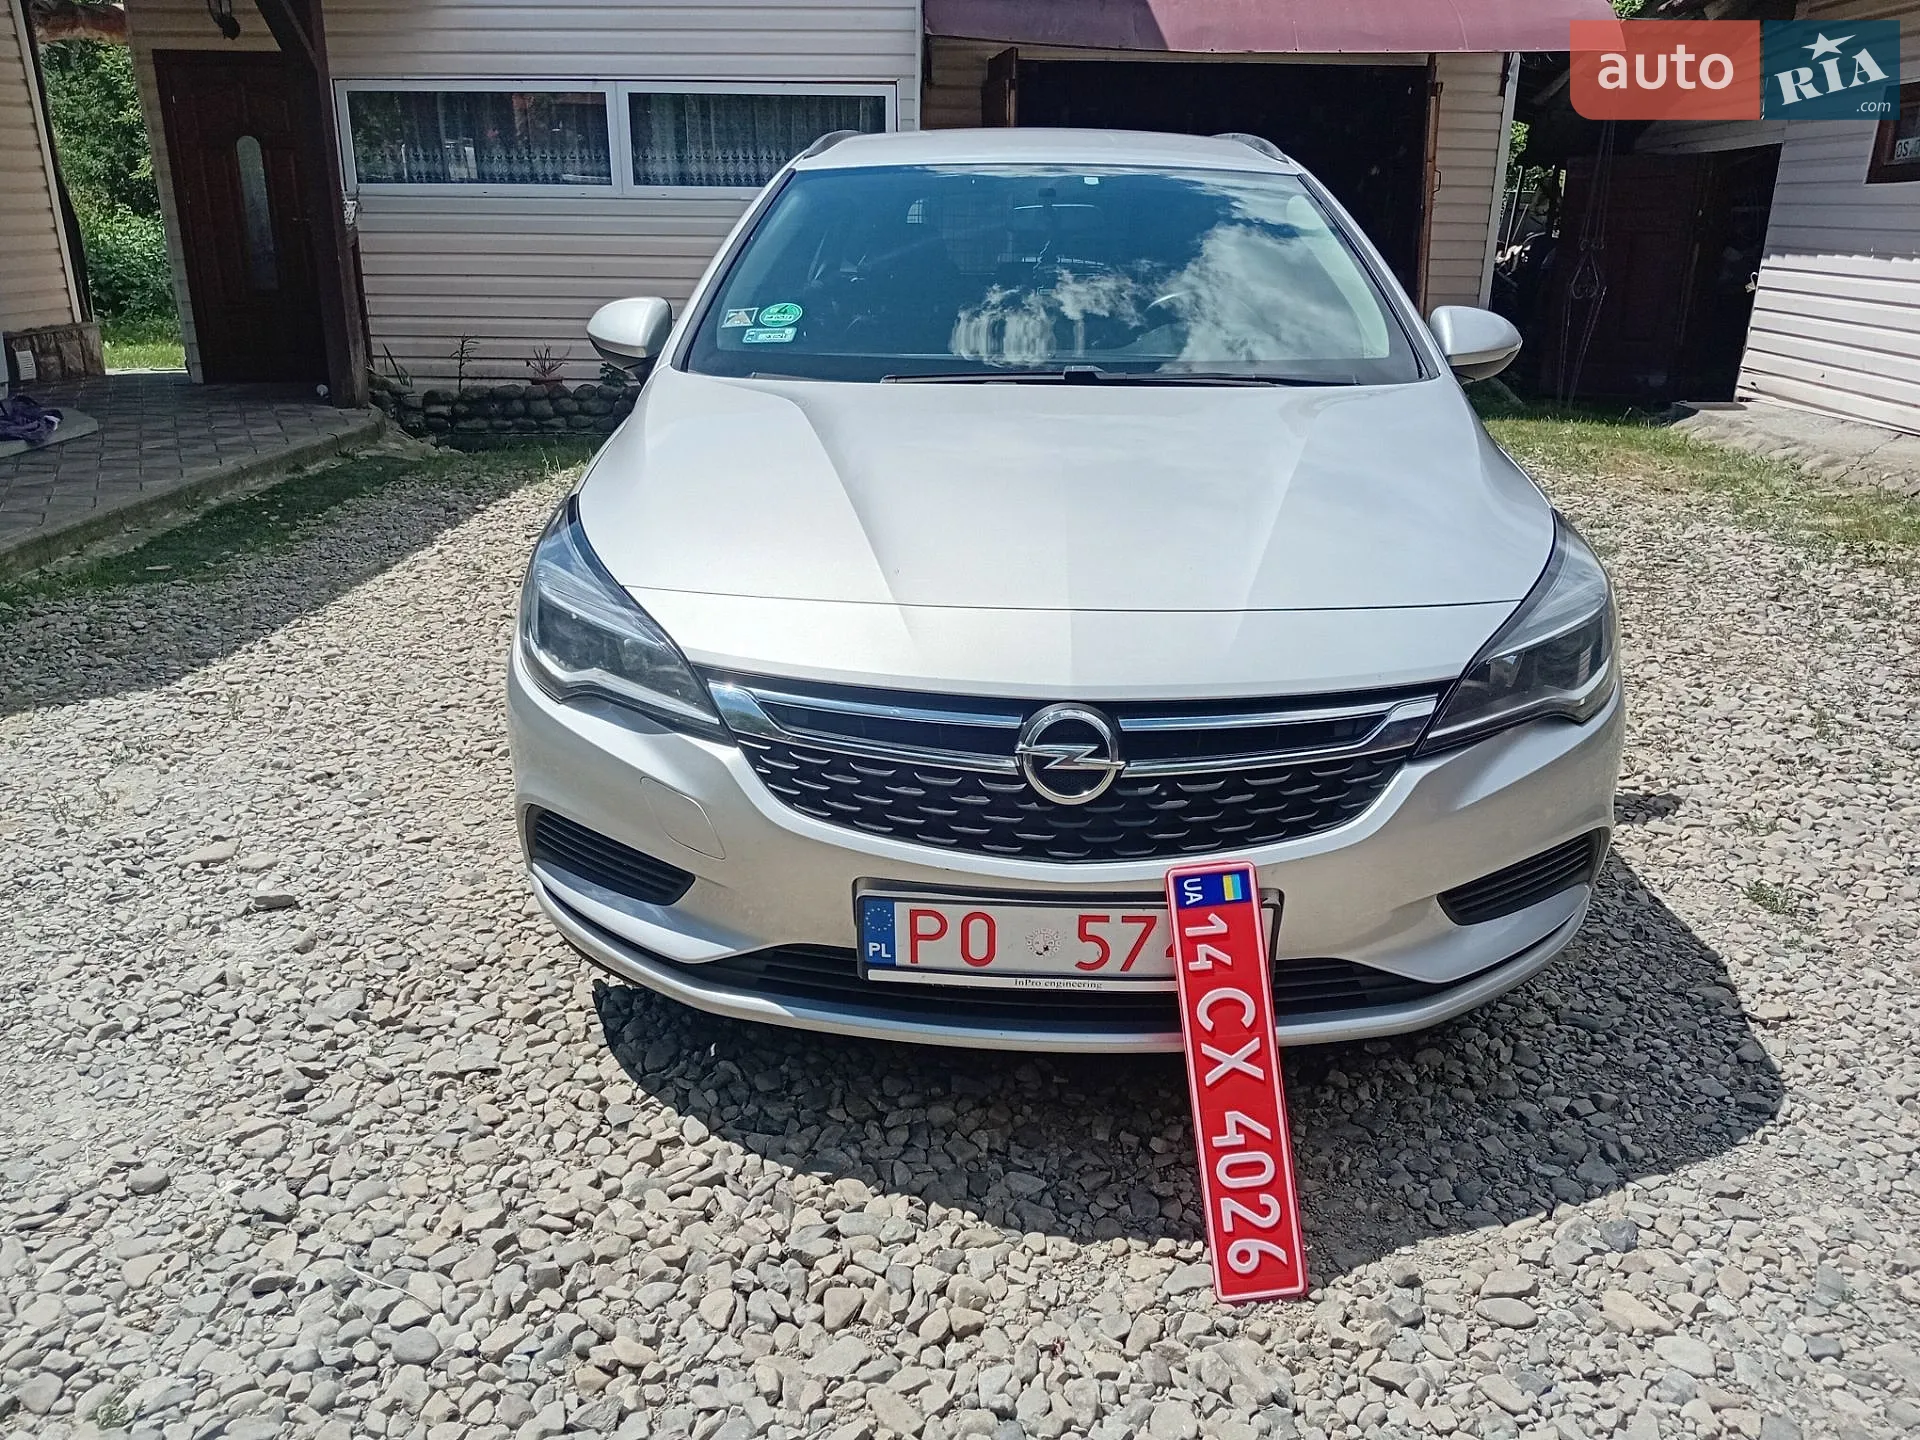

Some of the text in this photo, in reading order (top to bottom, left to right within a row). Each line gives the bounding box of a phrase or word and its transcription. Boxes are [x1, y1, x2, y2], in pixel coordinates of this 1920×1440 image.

[1183, 877, 1203, 905] UA
[868, 942, 891, 958] PL
[1075, 914, 1175, 972] 57
[1014, 978, 1103, 990] InPro engineering
[1185, 912, 1289, 1275] 14 CX 4026
